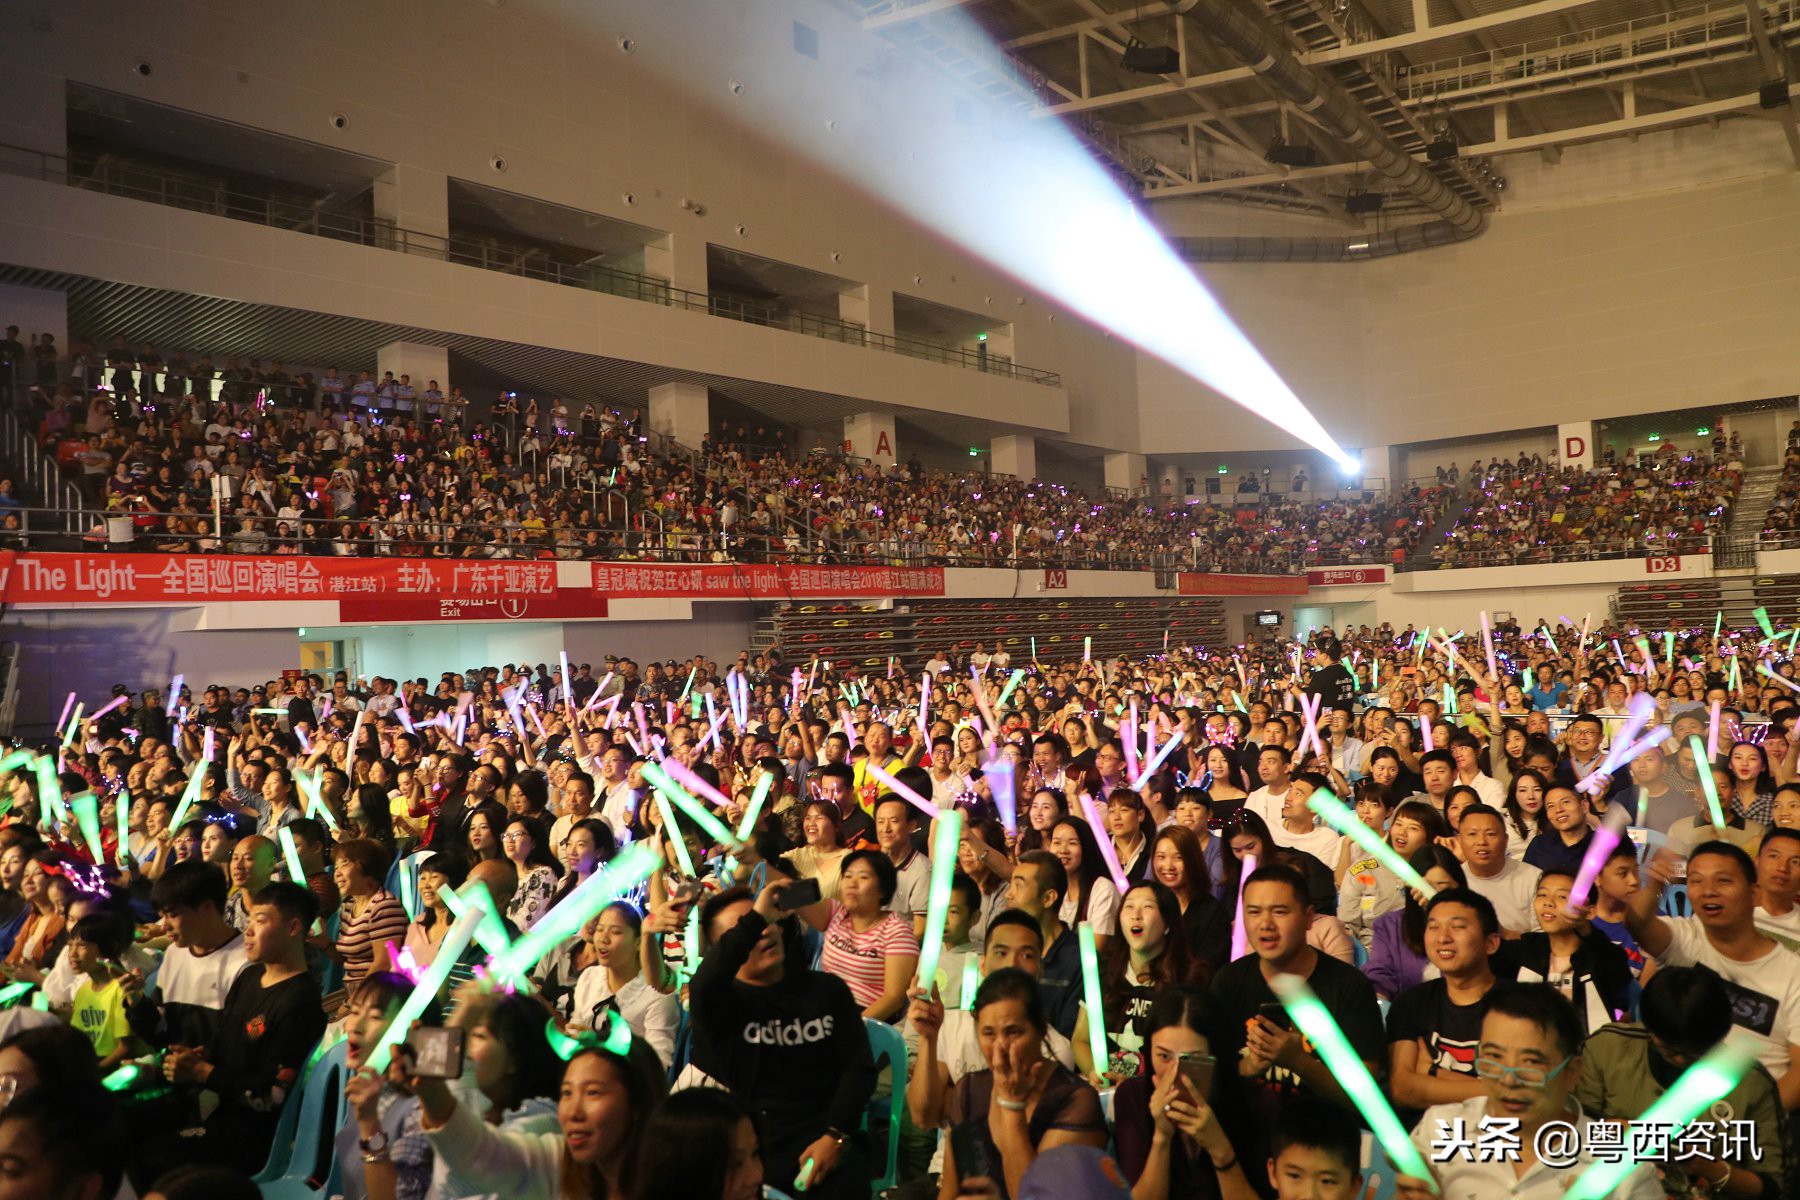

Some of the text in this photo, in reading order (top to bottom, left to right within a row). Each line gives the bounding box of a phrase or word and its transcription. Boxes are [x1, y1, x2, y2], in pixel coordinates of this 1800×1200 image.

[876, 431, 892, 456] A
[1566, 437, 1586, 458] D
[1651, 558, 1677, 572] D3
[16, 559, 67, 591] The
[706, 575, 729, 589] saw
[1048, 571, 1065, 588] A2
[440, 607, 461, 617] Exit
[744, 1014, 834, 1046] adidas
